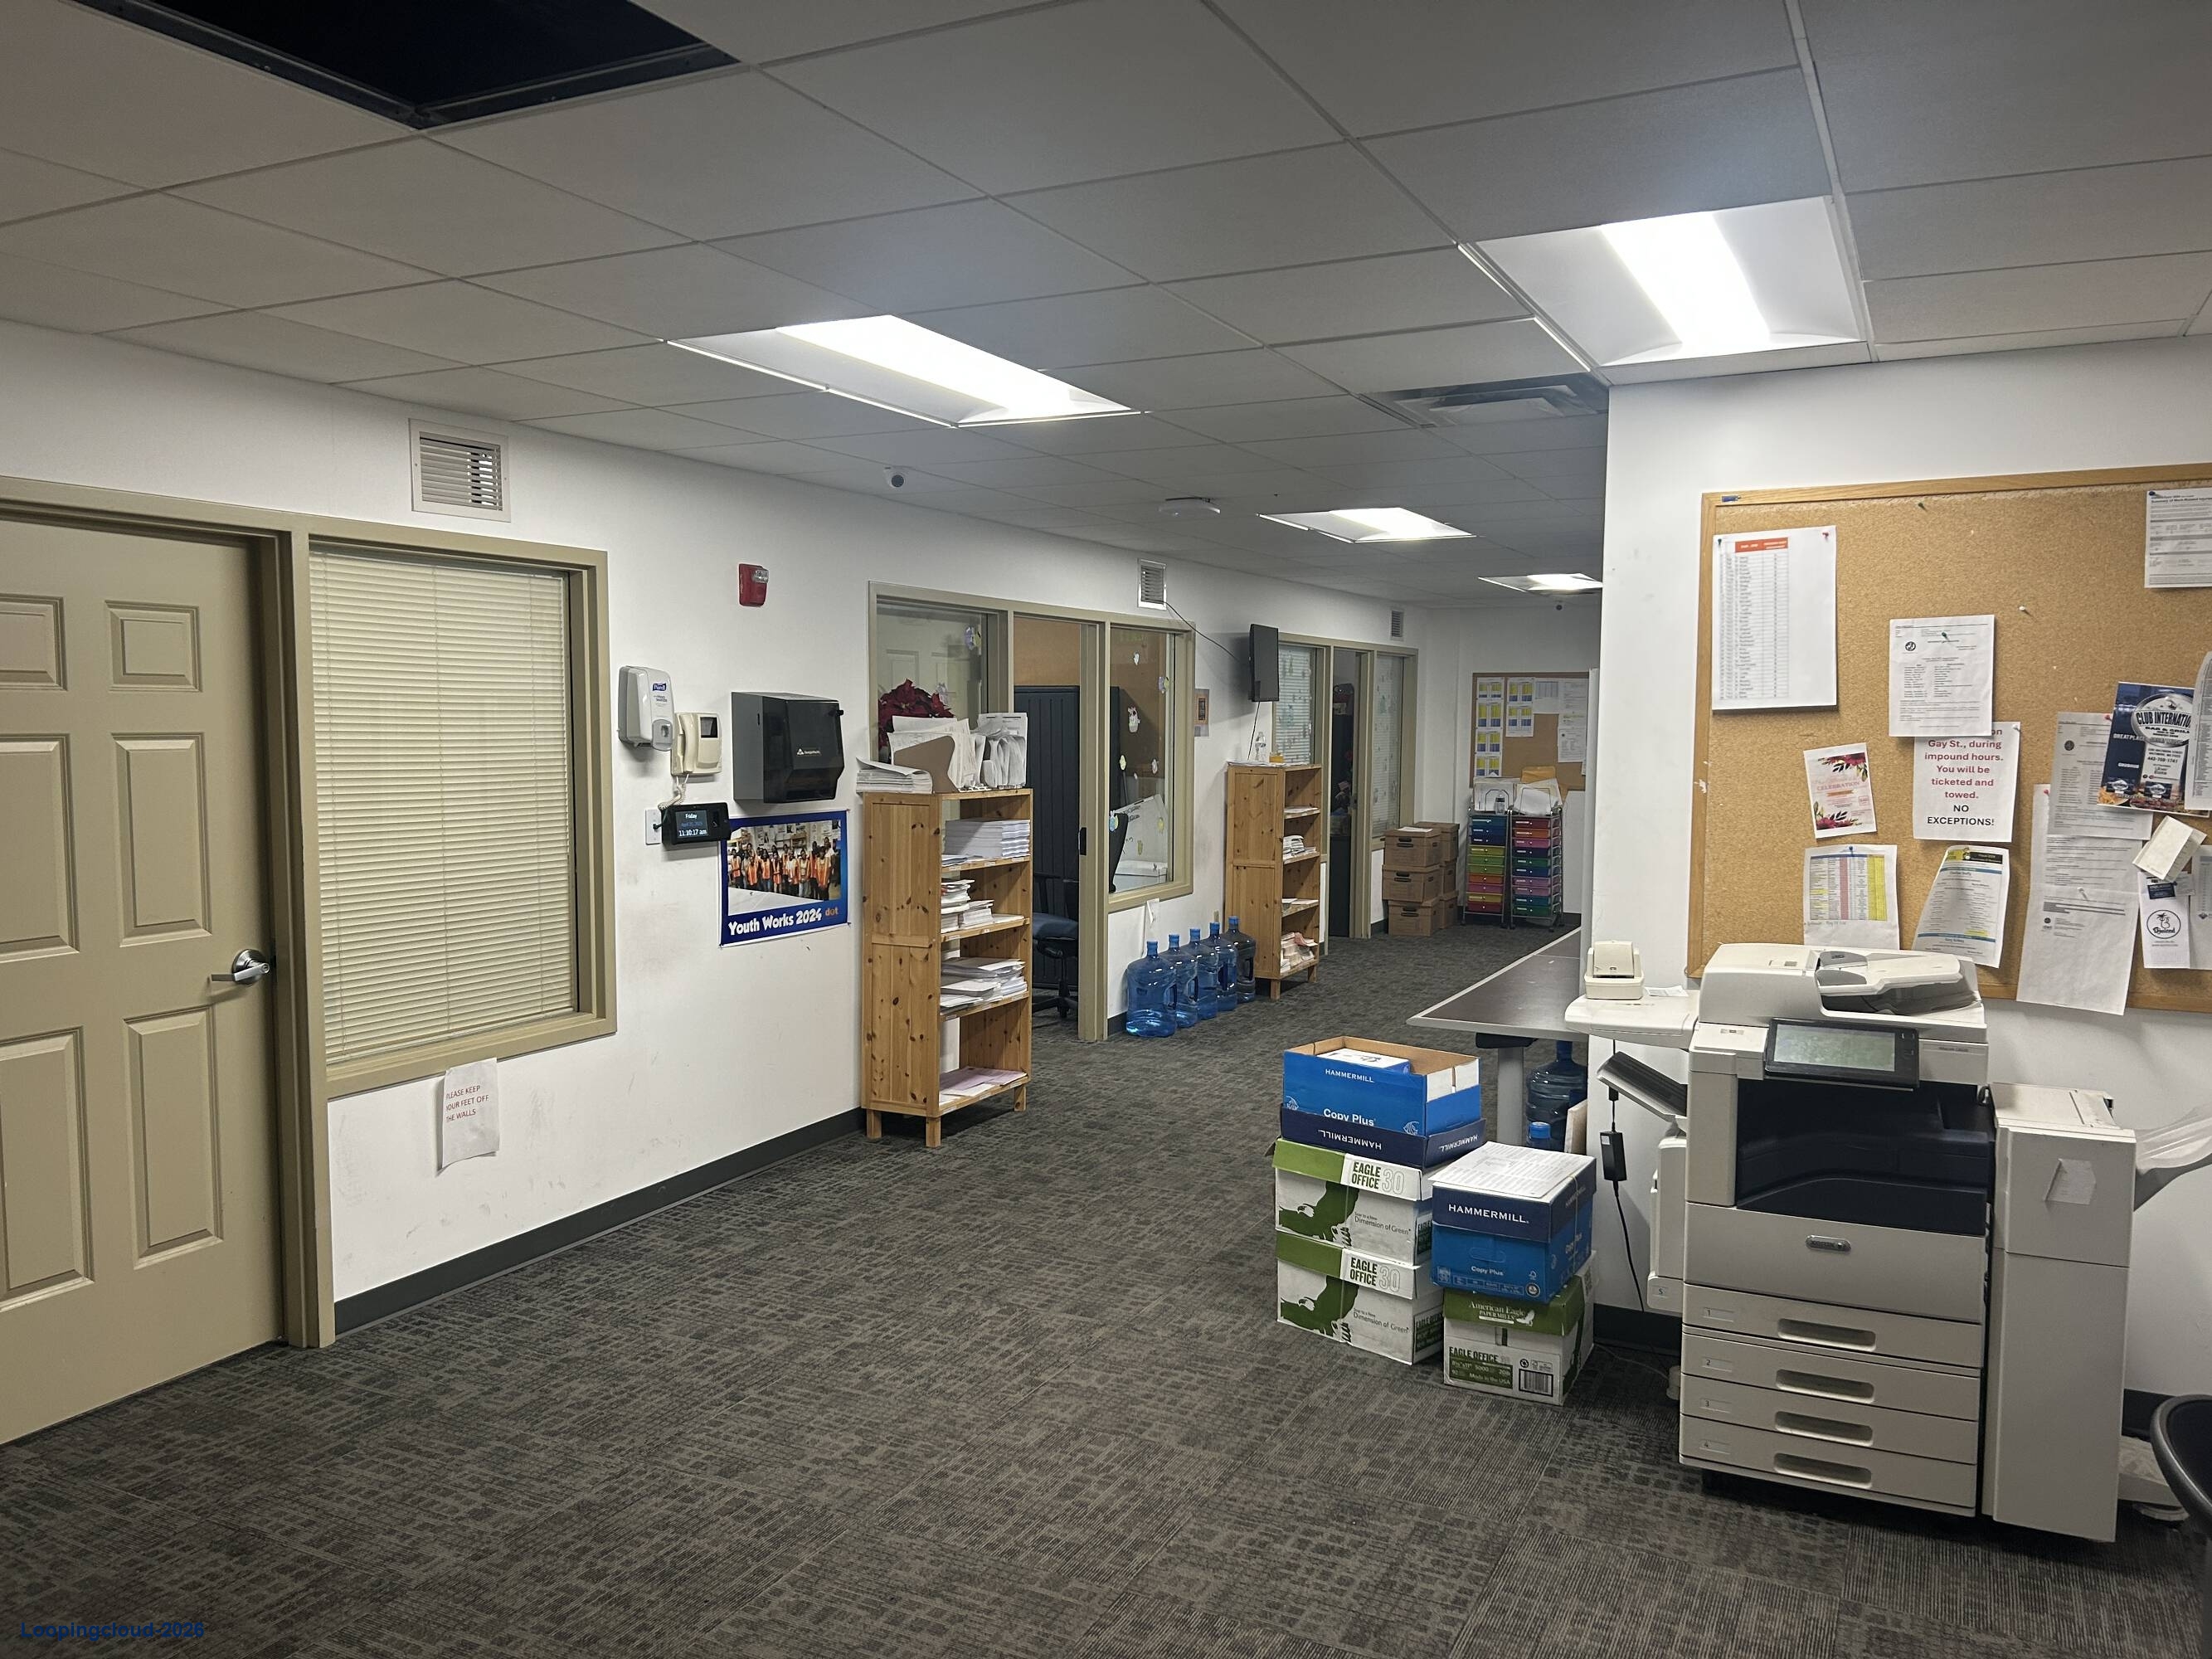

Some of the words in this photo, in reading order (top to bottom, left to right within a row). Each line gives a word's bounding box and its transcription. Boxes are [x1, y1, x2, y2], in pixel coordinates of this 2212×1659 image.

[2136, 712, 2154, 725] CLUB
[1928, 739, 1947, 748] Gay
[1949, 740, 1966, 748] St.,
[1969, 741, 2002, 749] during
[1924, 752, 1969, 761] impound
[1937, 765, 1955, 773] You
[1931, 777, 1972, 786] ticketed
[1945, 791, 1979, 799] towed.
[1927, 816, 1995, 825] EXCEPTIONS!
[728, 920, 760, 936] Youth
[761, 912, 795, 931] Works
[1325, 1068, 1374, 1082] HAMMERMILL
[465, 1085, 480, 1094] KEEP
[460, 1097, 474, 1106] FEET
[477, 1094, 489, 1103] OFF
[456, 1109, 476, 1119] WALLS
[1324, 1108, 1350, 1122] Copy
[1352, 1113, 1373, 1126] Plus
[1320, 1131, 1382, 1151] HAMMERMILL
[1441, 1134, 1479, 1152] HAMMERMILL
[1351, 1173, 1378, 1190] OFFICE
[1353, 1161, 1381, 1178] EAGLE
[1382, 1168, 1405, 1195] 30
[1448, 1204, 1529, 1224] HAMMERMILL
[1354, 1215, 1384, 1229] Dimension
[1350, 1257, 1378, 1274] EAGLE
[1378, 1265, 1401, 1293] 30
[1471, 1265, 1488, 1274] Copy
[1350, 1268, 1376, 1287] OFFICE
[1469, 1301, 1505, 1313] American
[1353, 1311, 1383, 1326] Dimension
[1449, 1347, 1471, 1358] EAGLE
[1473, 1350, 1499, 1362] OFFICE
